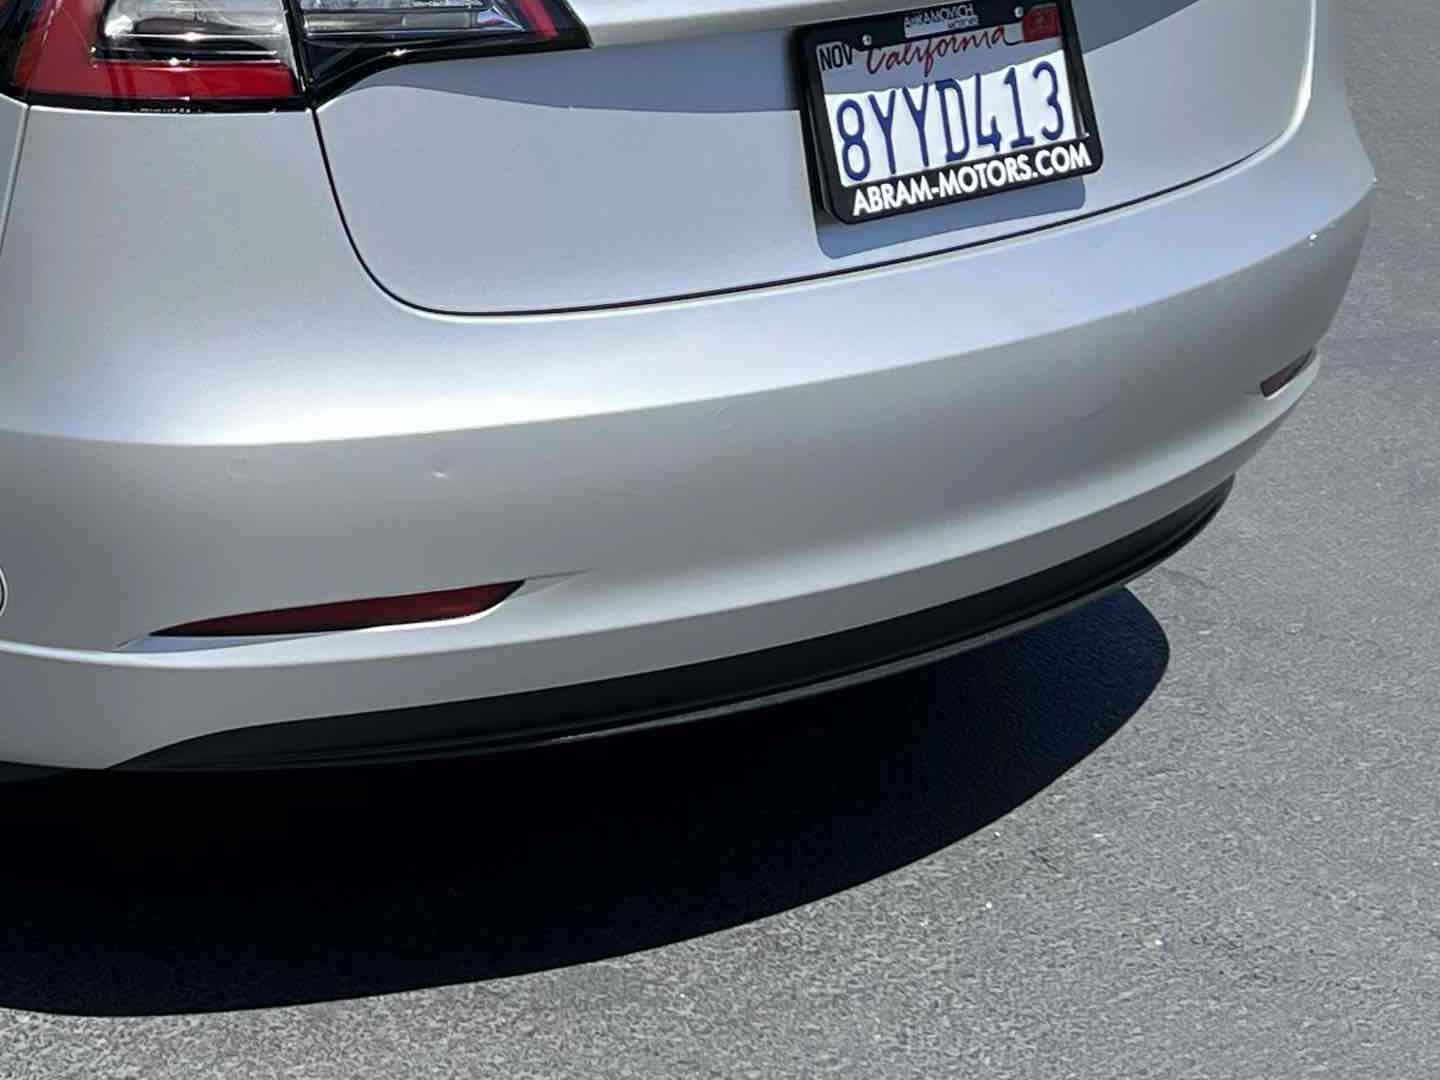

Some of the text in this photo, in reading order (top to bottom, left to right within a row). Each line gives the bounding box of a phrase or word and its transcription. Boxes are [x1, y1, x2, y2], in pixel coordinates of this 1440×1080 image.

[819, 44, 855, 72] NOV
[864, 23, 1022, 77] California
[836, 60, 1066, 182] 8YYD413
[852, 142, 1092, 217] ABRAM-MOTORS.COM
